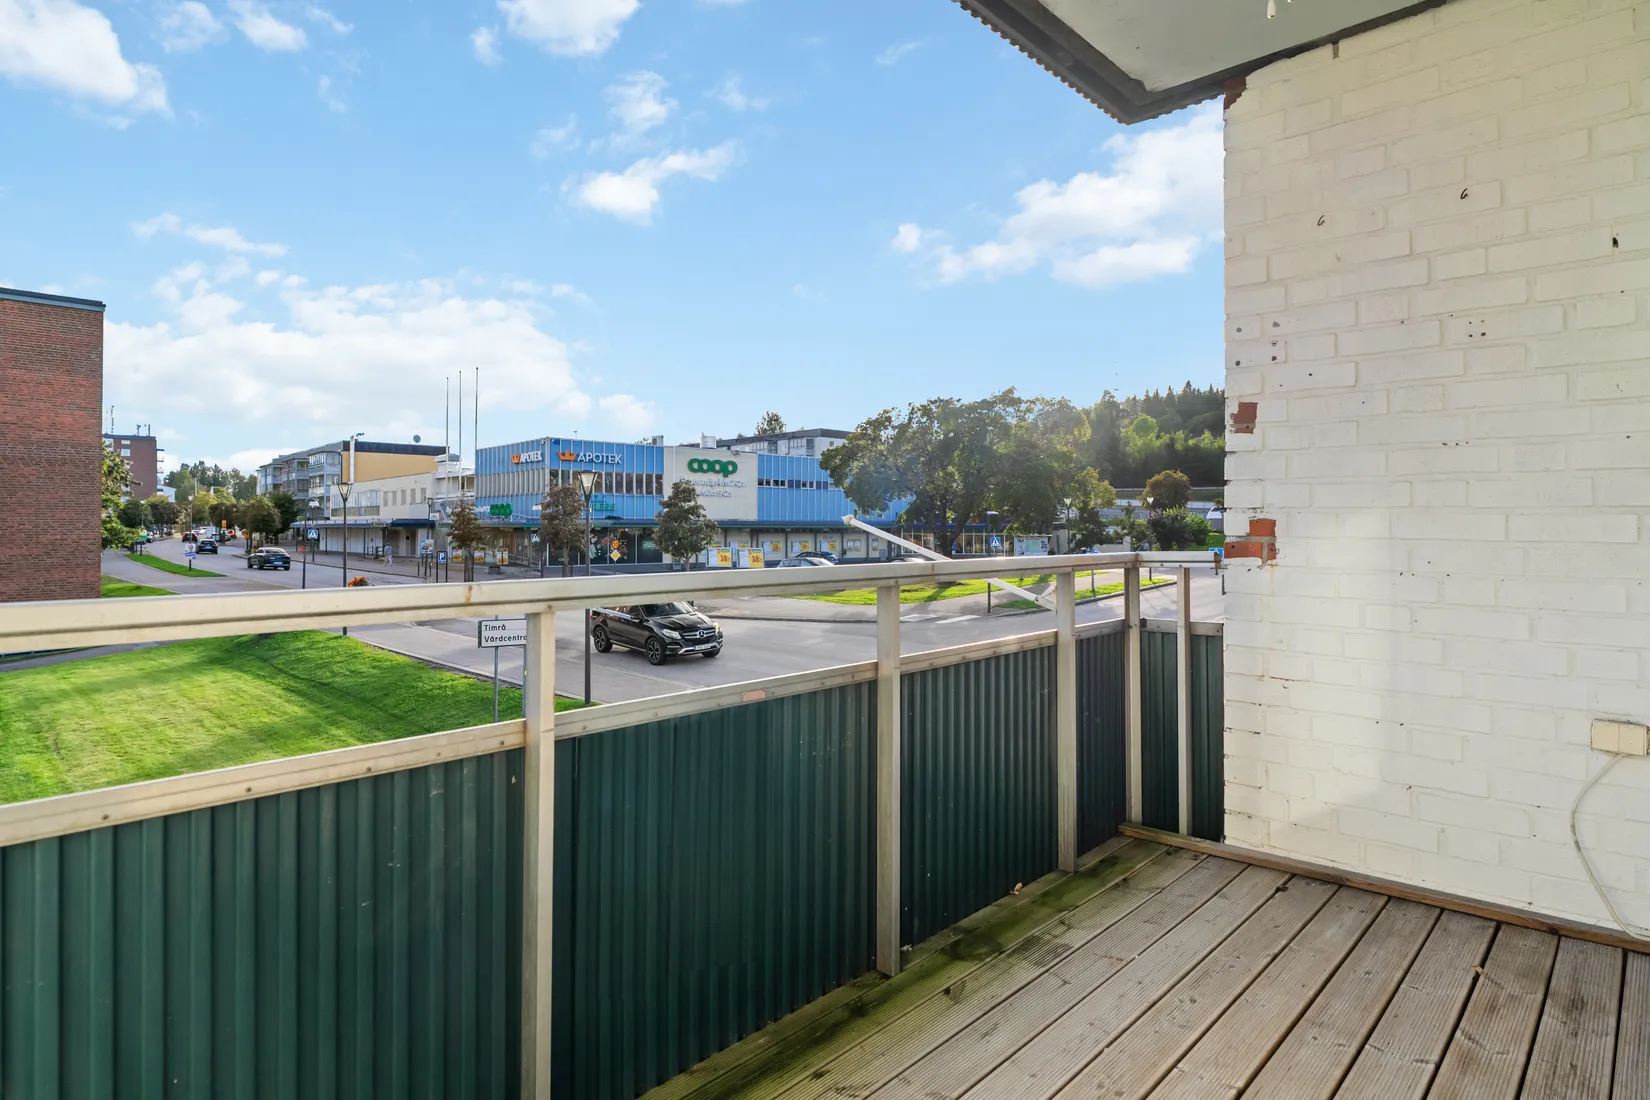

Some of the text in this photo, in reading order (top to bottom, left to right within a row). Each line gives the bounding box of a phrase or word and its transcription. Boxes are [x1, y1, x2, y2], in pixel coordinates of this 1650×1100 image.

[519, 450, 543, 463] APOTEK
[577, 451, 622, 464] APOTEK
[687, 458, 738, 478] coop
[484, 623, 506, 631] Timrå
